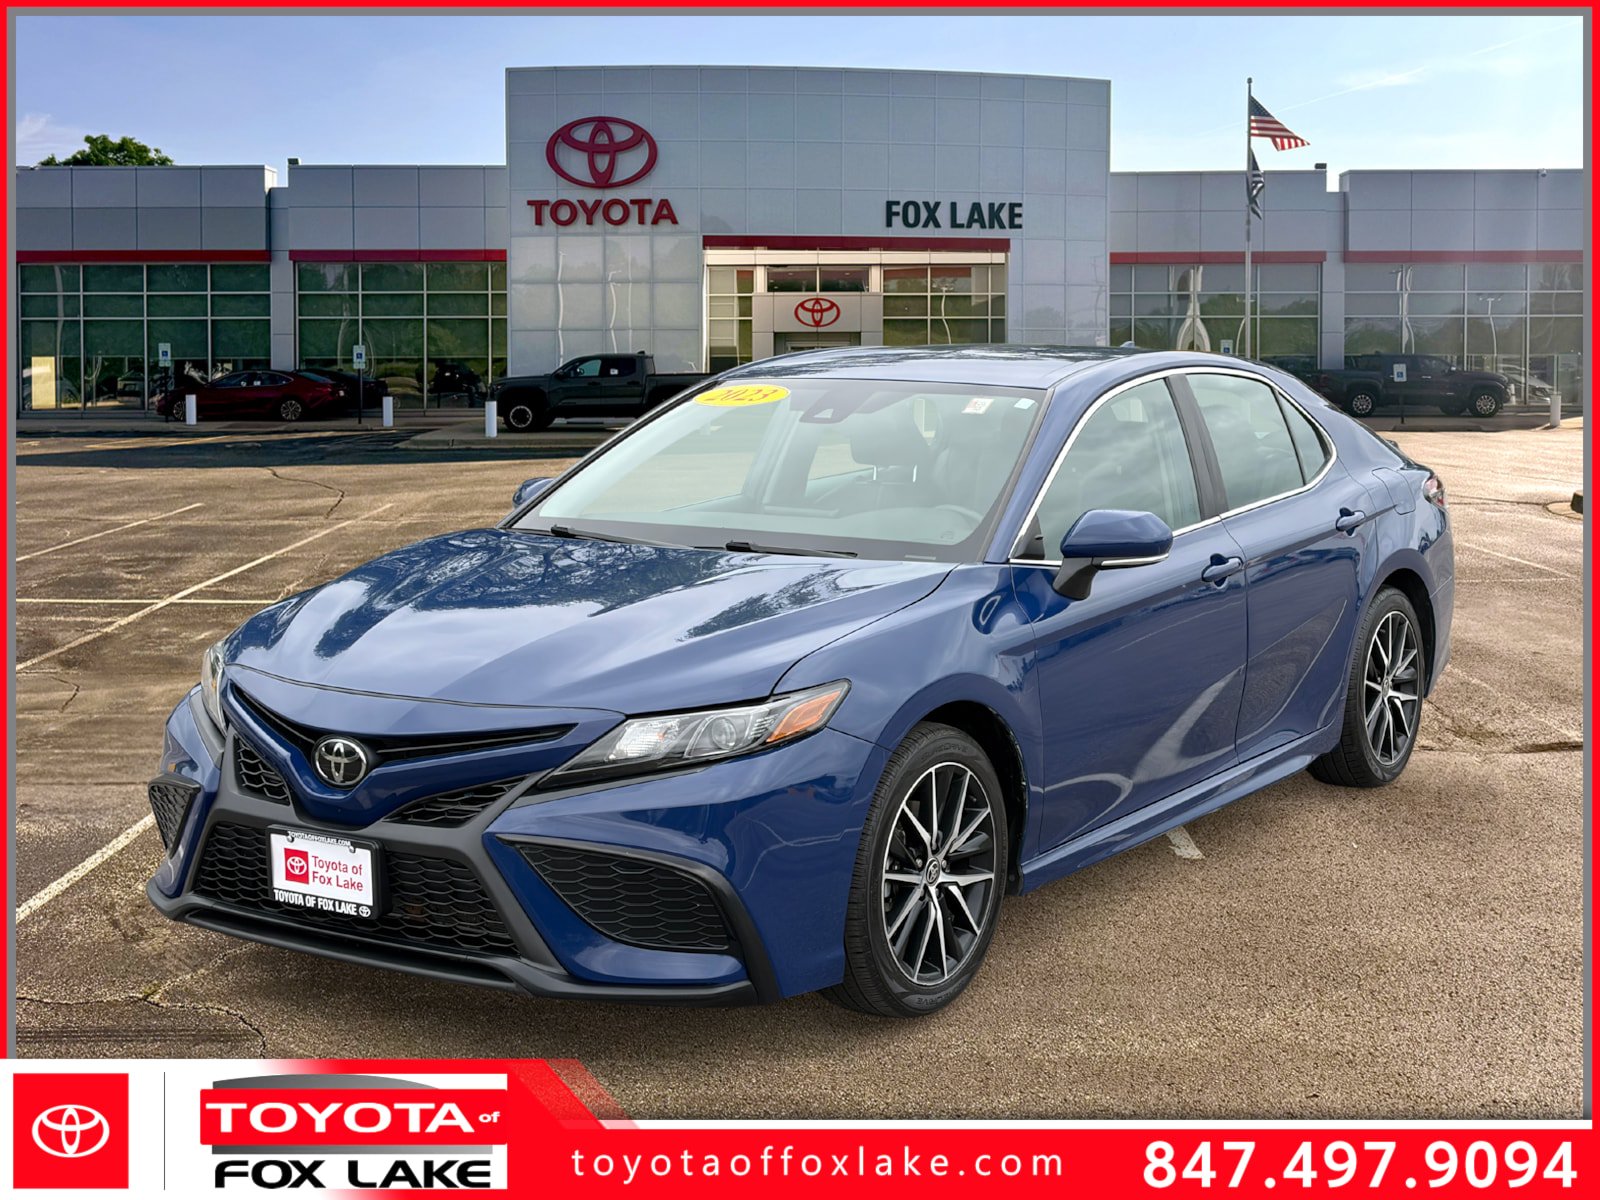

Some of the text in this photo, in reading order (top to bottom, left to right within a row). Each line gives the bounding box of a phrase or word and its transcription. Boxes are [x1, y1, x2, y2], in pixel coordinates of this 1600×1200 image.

[527, 199, 678, 226] TOYOTA
[886, 201, 1023, 229] FOX LAKE
[704, 388, 778, 402] 2023
[312, 855, 362, 876] Toyota of
[312, 871, 363, 891] Fox Lake
[273, 889, 357, 916] TOYOTA OF FOX LAKE
